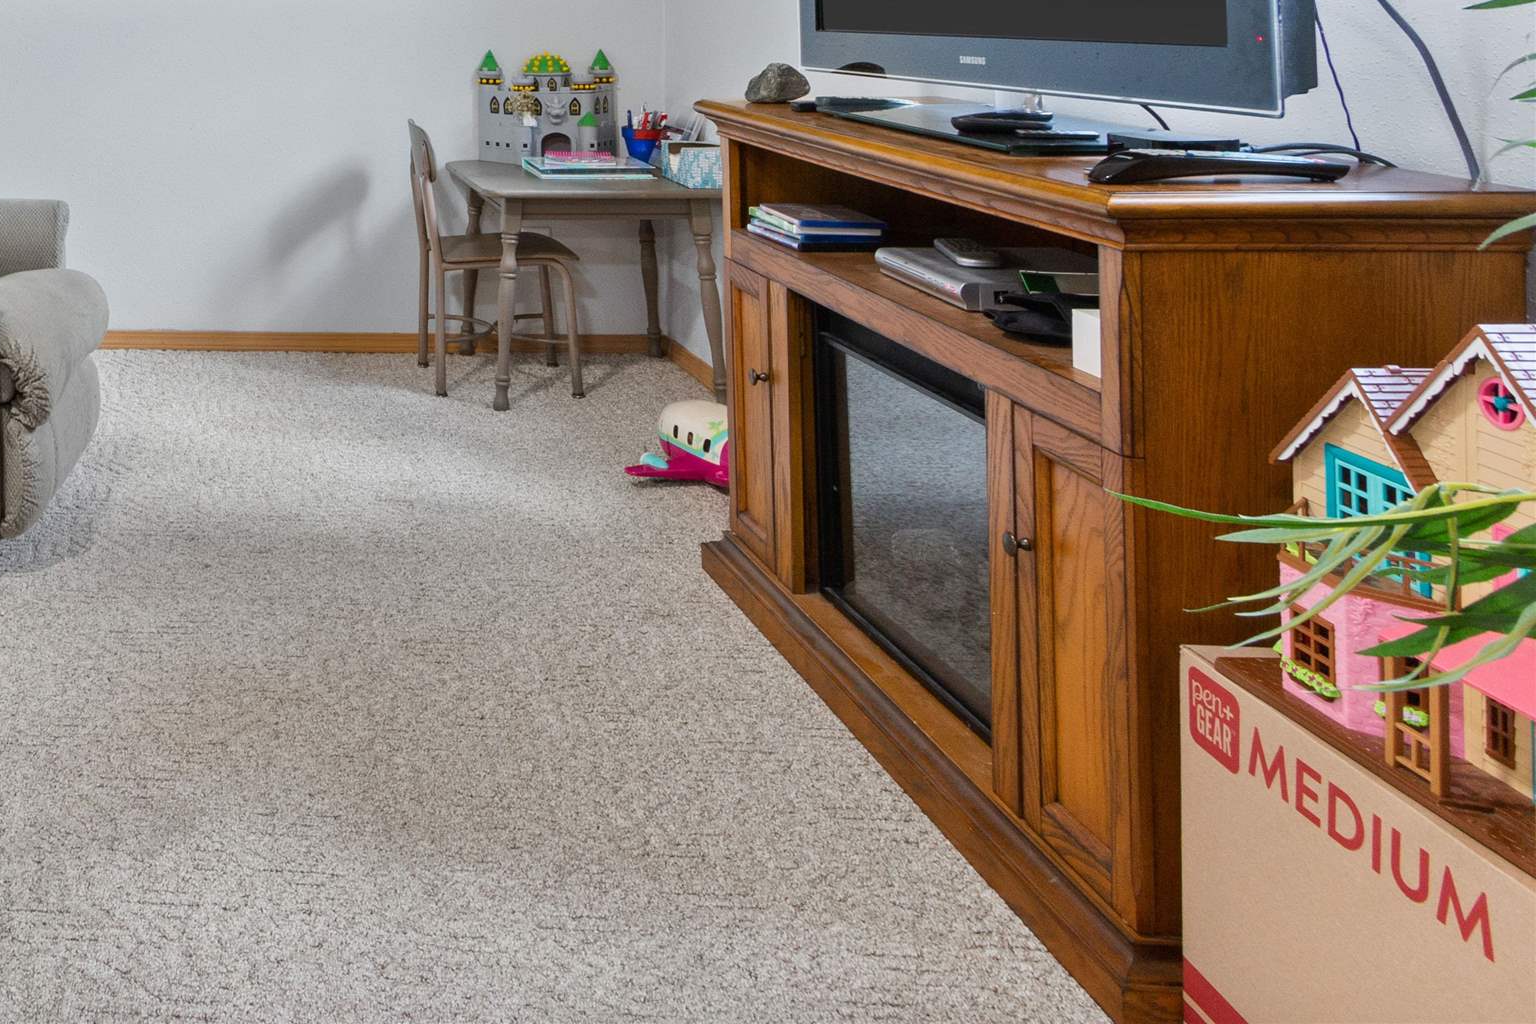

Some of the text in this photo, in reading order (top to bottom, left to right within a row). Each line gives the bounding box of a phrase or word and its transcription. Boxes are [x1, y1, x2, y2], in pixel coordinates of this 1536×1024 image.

[959, 56, 986, 65] SAMSUNG
[1195, 703, 1233, 759] GEAR
[1248, 726, 1496, 963] MEDIUM
